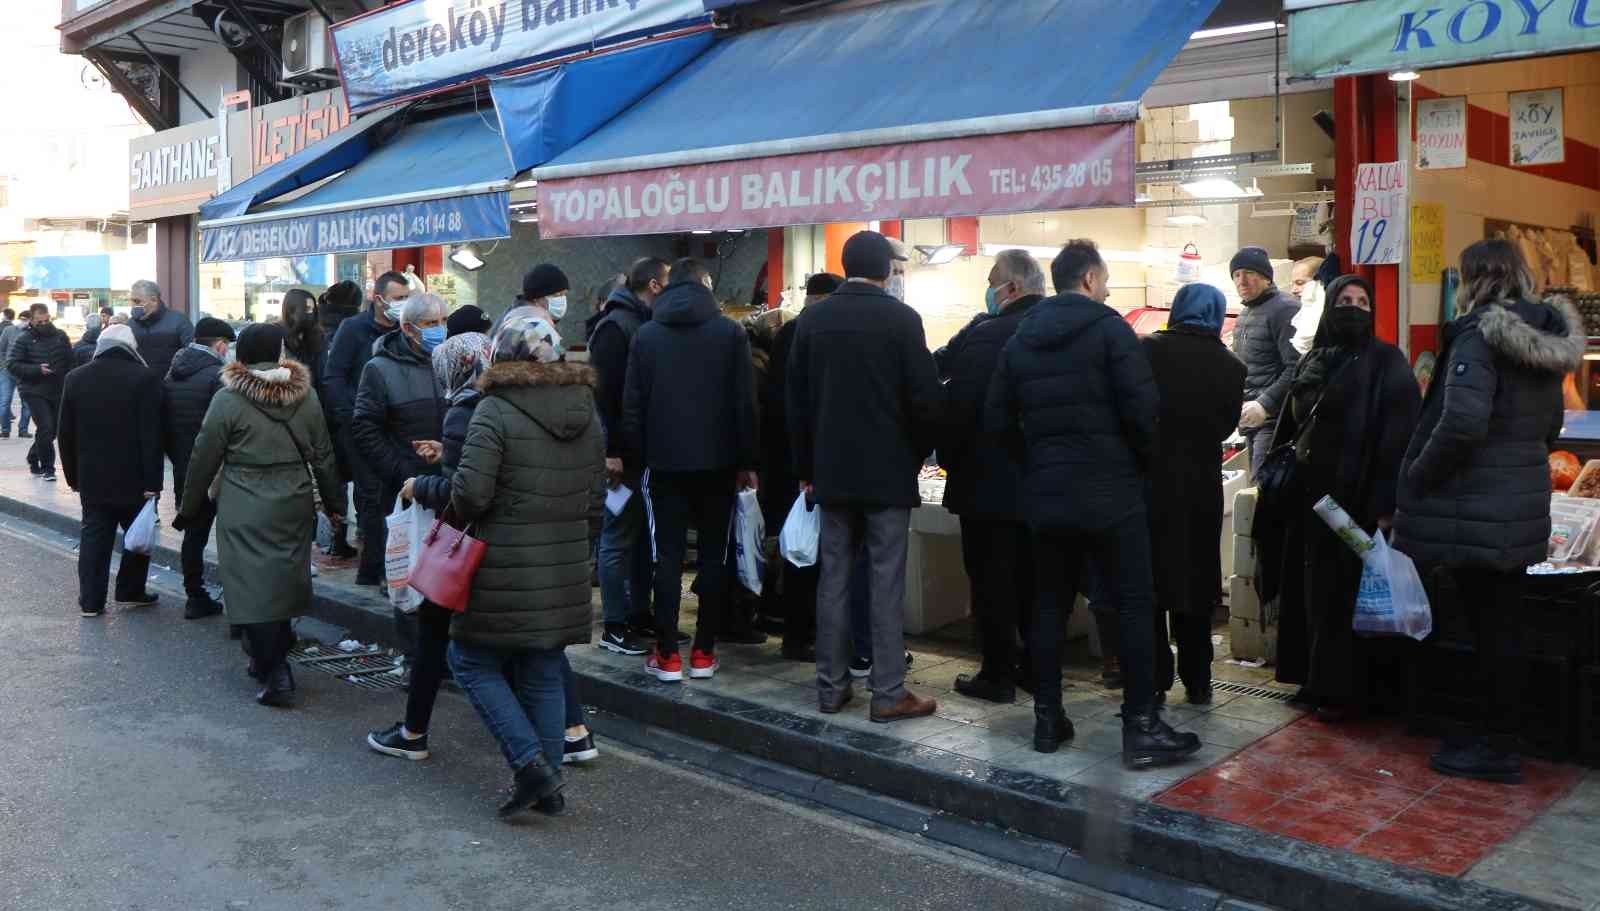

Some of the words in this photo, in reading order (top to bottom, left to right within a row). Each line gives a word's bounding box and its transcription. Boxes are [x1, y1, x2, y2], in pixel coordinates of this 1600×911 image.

[382, 0, 506, 72] dereköy
[131, 135, 220, 192] SAATHANE
[550, 173, 731, 223] TOPALOĞLU
[741, 154, 975, 213] BALIKÇILIK
[990, 168, 1026, 194] TEL:
[1030, 165, 1063, 192] 435
[1090, 159, 1113, 188] 05
[241, 220, 310, 254] DEREKÖY
[317, 212, 404, 250] BALIKÇISI
[411, 215, 431, 235] 431
[448, 210, 463, 232] 88
